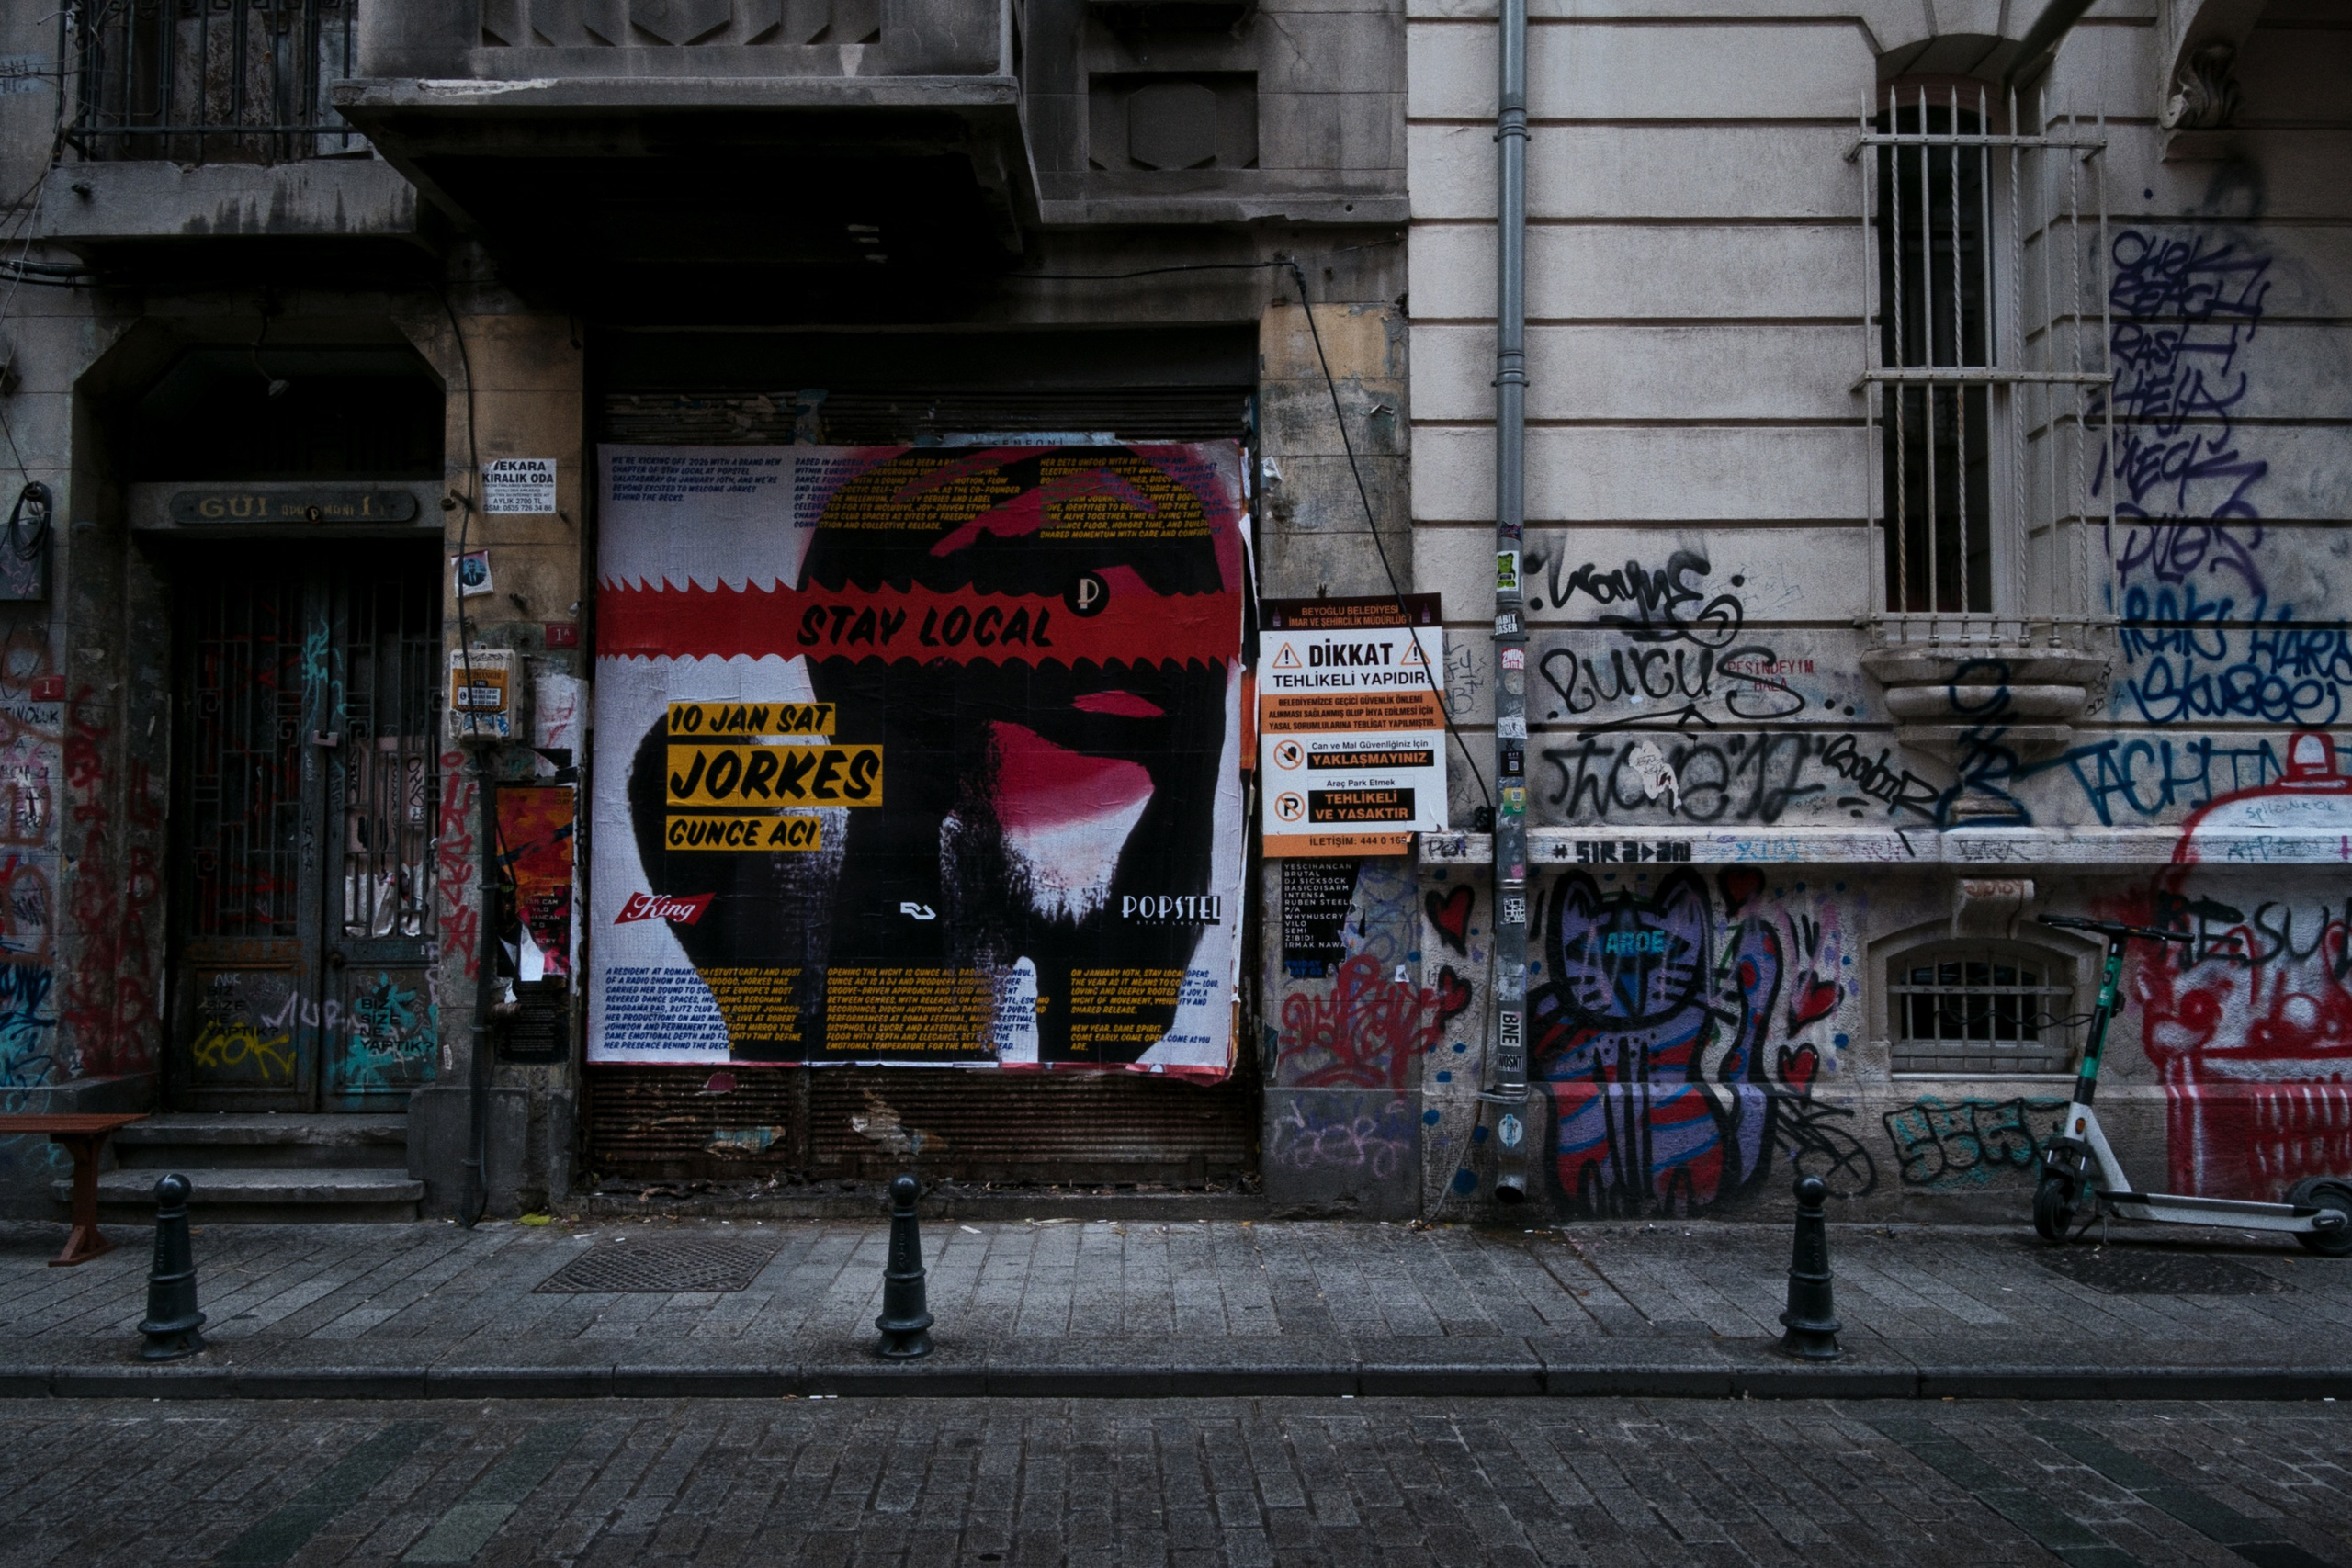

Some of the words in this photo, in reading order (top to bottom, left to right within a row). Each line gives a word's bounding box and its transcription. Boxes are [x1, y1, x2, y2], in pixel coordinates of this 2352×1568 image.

[531, 473, 553, 482] ODA
[843, 521, 860, 530] AND
[862, 521, 905, 530] COLLECTIVE
[1302, 605, 1344, 616] BEYOĞLU
[1347, 604, 1398, 615] BELEDİYESİ
[797, 604, 907, 645] STAY
[919, 605, 1053, 646] LOCAL
[1289, 616, 1308, 626] İMAR
[1311, 618, 1320, 626] VE
[1320, 616, 1362, 628] ŞEHİRCİLİK
[1309, 639, 1393, 667] DİKKAT
[1273, 671, 1355, 687] TEHLİKELİ
[44, 682, 51, 694] 1
[1279, 697, 1333, 706] BELEDİYEMİZCE
[1335, 697, 1358, 705] GEÇİCİ
[1360, 696, 1394, 705] GÜVENLİK
[1396, 695, 1422, 704] ÖNLEMİ
[1269, 710, 1302, 718] ALINMASI
[1304, 708, 1343, 718] SAĞLANMIŞ
[1366, 707, 1383, 716] İHYA
[1385, 706, 1418, 716] EDİLMESİ
[1419, 706, 1433, 716] İÇİN
[671, 705, 703, 732] 10
[710, 705, 770, 732] JAN
[776, 705, 832, 732] SAT
[1270, 722, 1291, 730] YASAL
[1294, 721, 1351, 729] SORUMLULARINA
[1354, 719, 1386, 728] TEBLİGAT
[1388, 718, 1436, 728] YAPILMIŞTIR.
[1342, 741, 1357, 750] Mal
[1359, 740, 1411, 750] Güvenliğiniz
[1413, 739, 1428, 749] İçin
[1312, 752, 1427, 767] YAKLAŞMAYINIZ
[670, 750, 880, 799] JORKES
[1327, 780, 1345, 788] Araç
[1325, 790, 1397, 805] TEHLİKELİ
[1316, 809, 1333, 820] VE
[1338, 807, 1408, 819] YASAKTIR
[669, 819, 762, 846] GUNCE
[768, 821, 818, 847] ACI
[1309, 837, 1357, 847] İLETİŞİM:
[627, 893, 696, 922] King
[1122, 896, 1220, 919] POPSTEL
[1071, 969, 1082, 977] ON
[1084, 969, 1120, 977] JANUARY
[1144, 969, 1162, 977] STAY
[1187, 969, 1209, 977] OPENS
[606, 986, 639, 995] CARRIED
[641, 986, 655, 995] HER
[658, 986, 683, 995] SOUND
[685, 986, 695, 995] TO
[720, 986, 730, 995] OF
[772, 986, 793, 995] MOST
[1071, 1006, 1102, 1014] SHARED
[207, 1026, 279, 1037] YAPTIK?
[1071, 1024, 1089, 1032] NEW
[1113, 1024, 1134, 1032] SAME
[1502, 1013, 1519, 1045] BNE
[360, 1041, 434, 1052] YAPTIK?
[604, 1042, 619, 1050] HER
[621, 1042, 661, 1050] PRESENCE
[662, 1042, 690, 1050] BEHIND
[693, 1042, 707, 1050] THE
